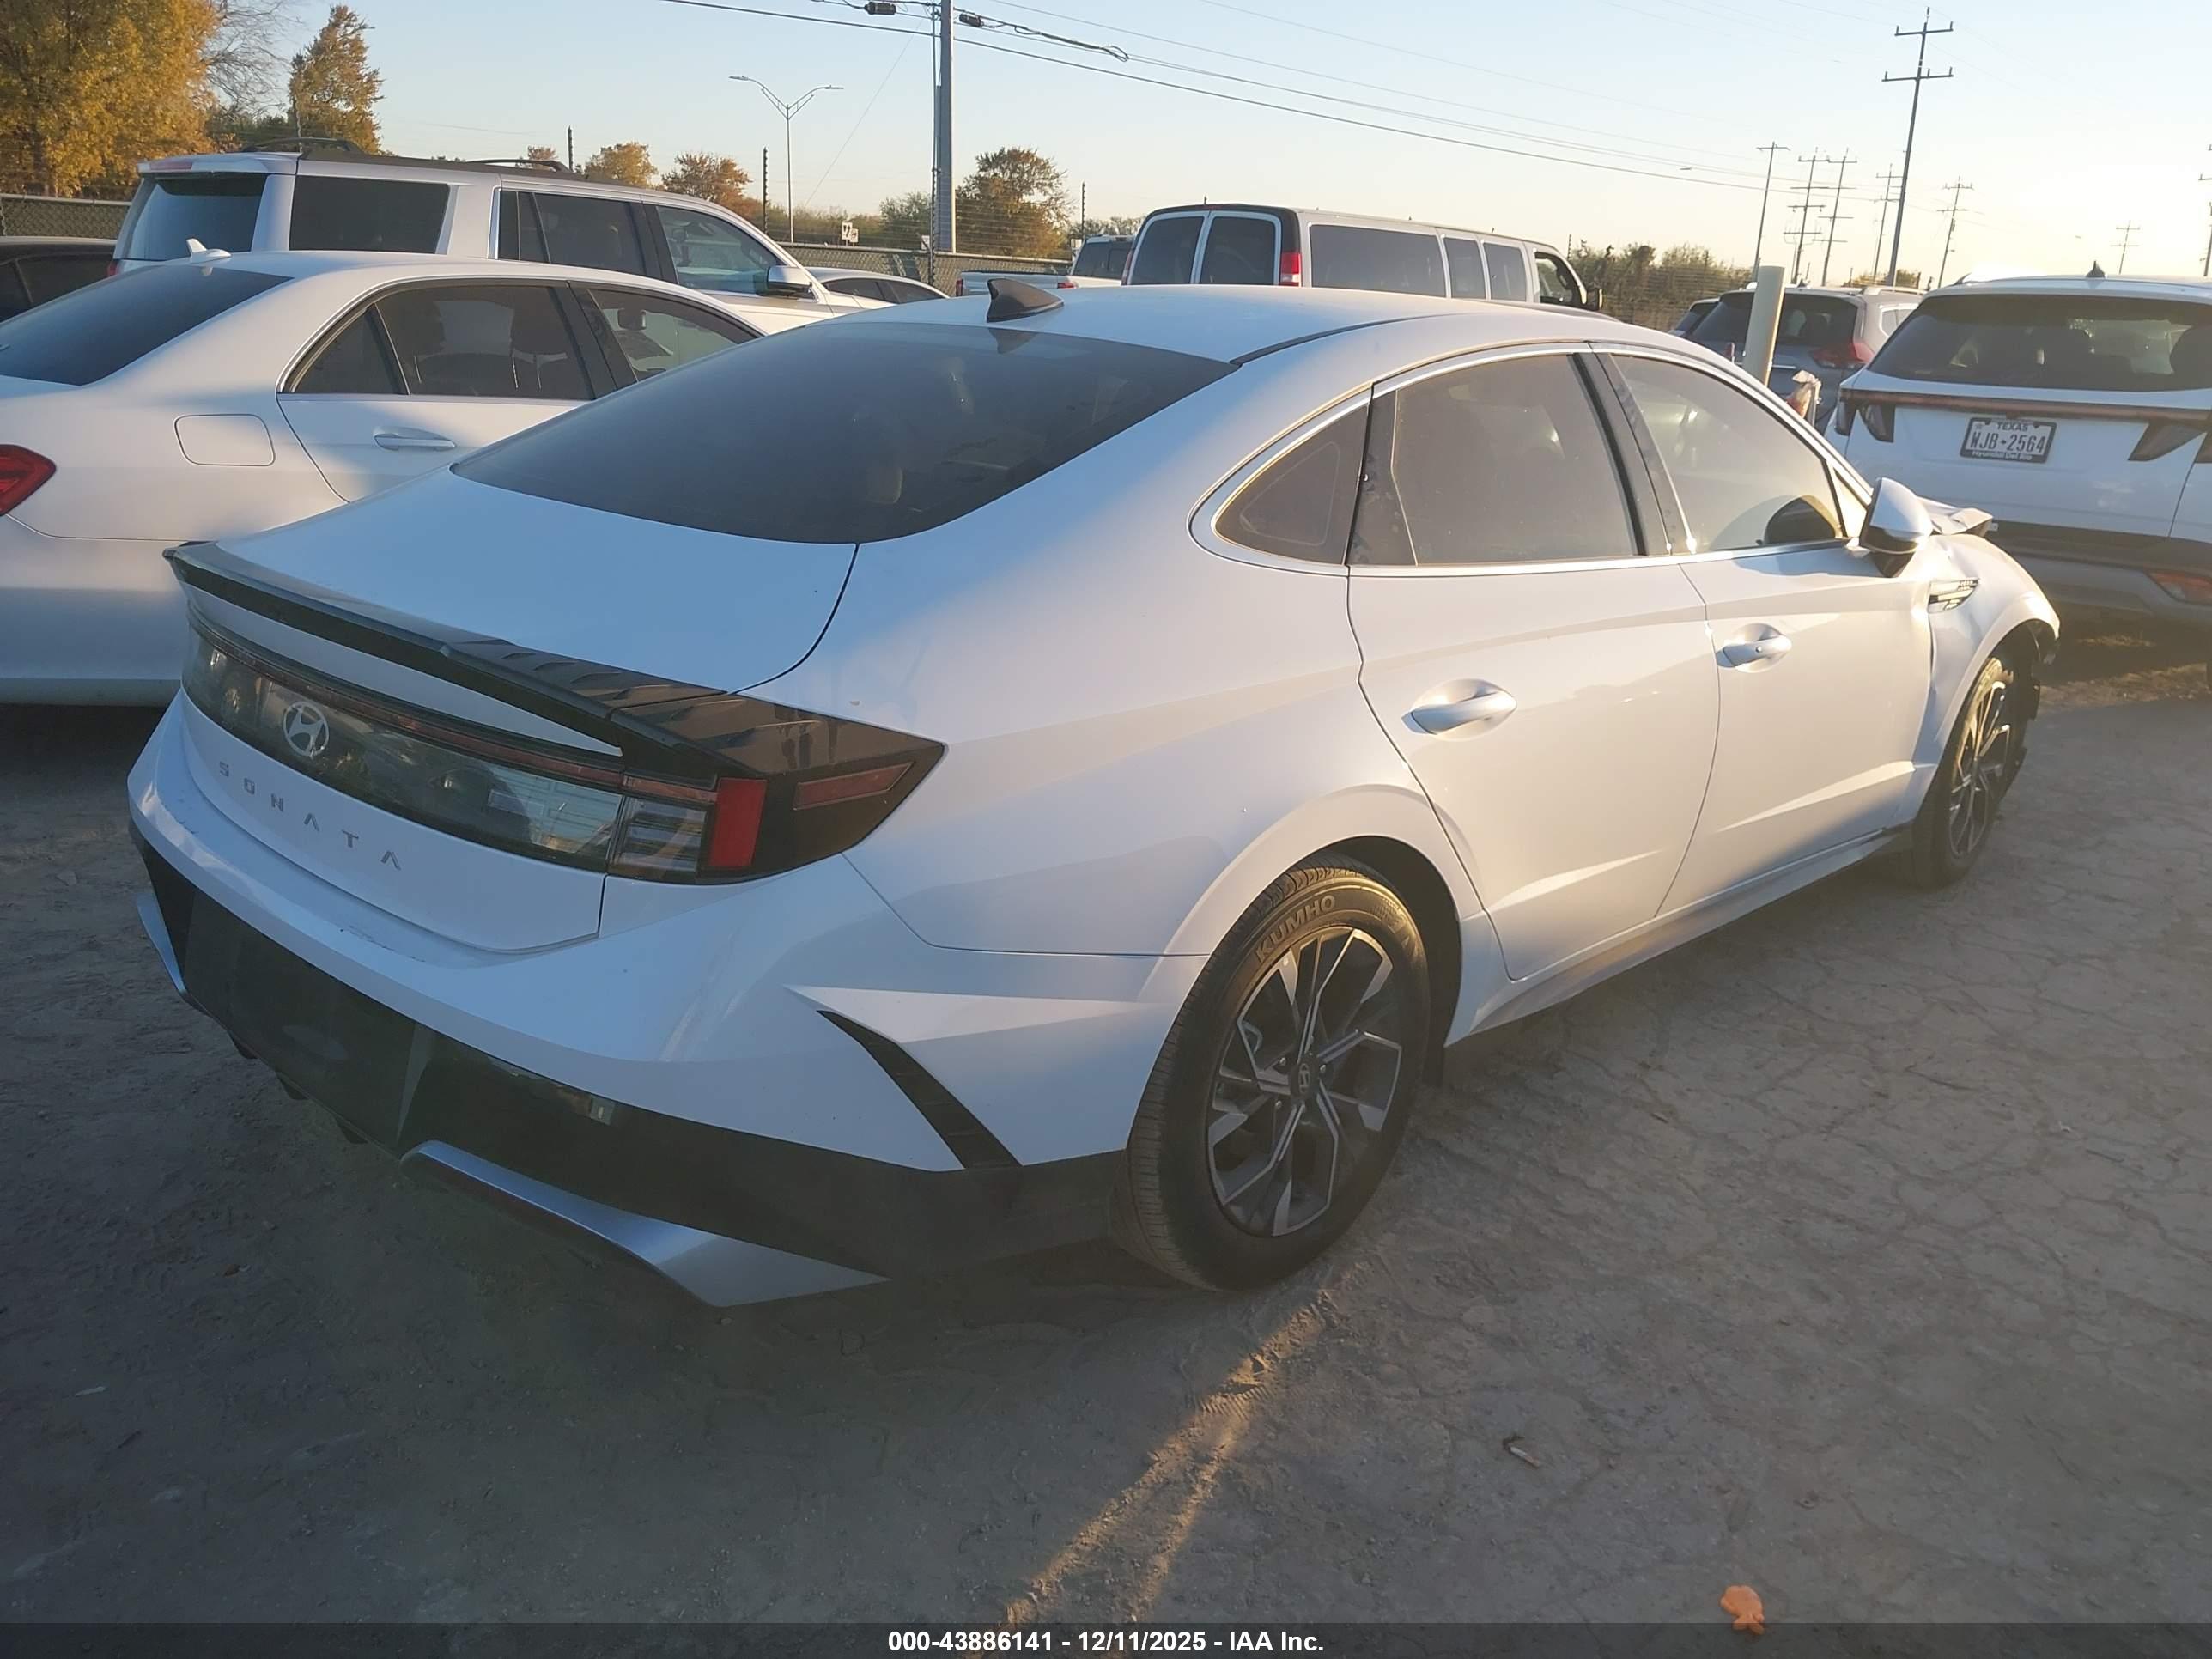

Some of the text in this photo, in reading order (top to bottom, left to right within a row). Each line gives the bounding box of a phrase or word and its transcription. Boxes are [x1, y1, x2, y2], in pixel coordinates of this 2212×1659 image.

[1996, 422, 2028, 431] TEXAS
[219, 761, 401, 871] SONATA
[1255, 895, 1335, 963] KUMHO
